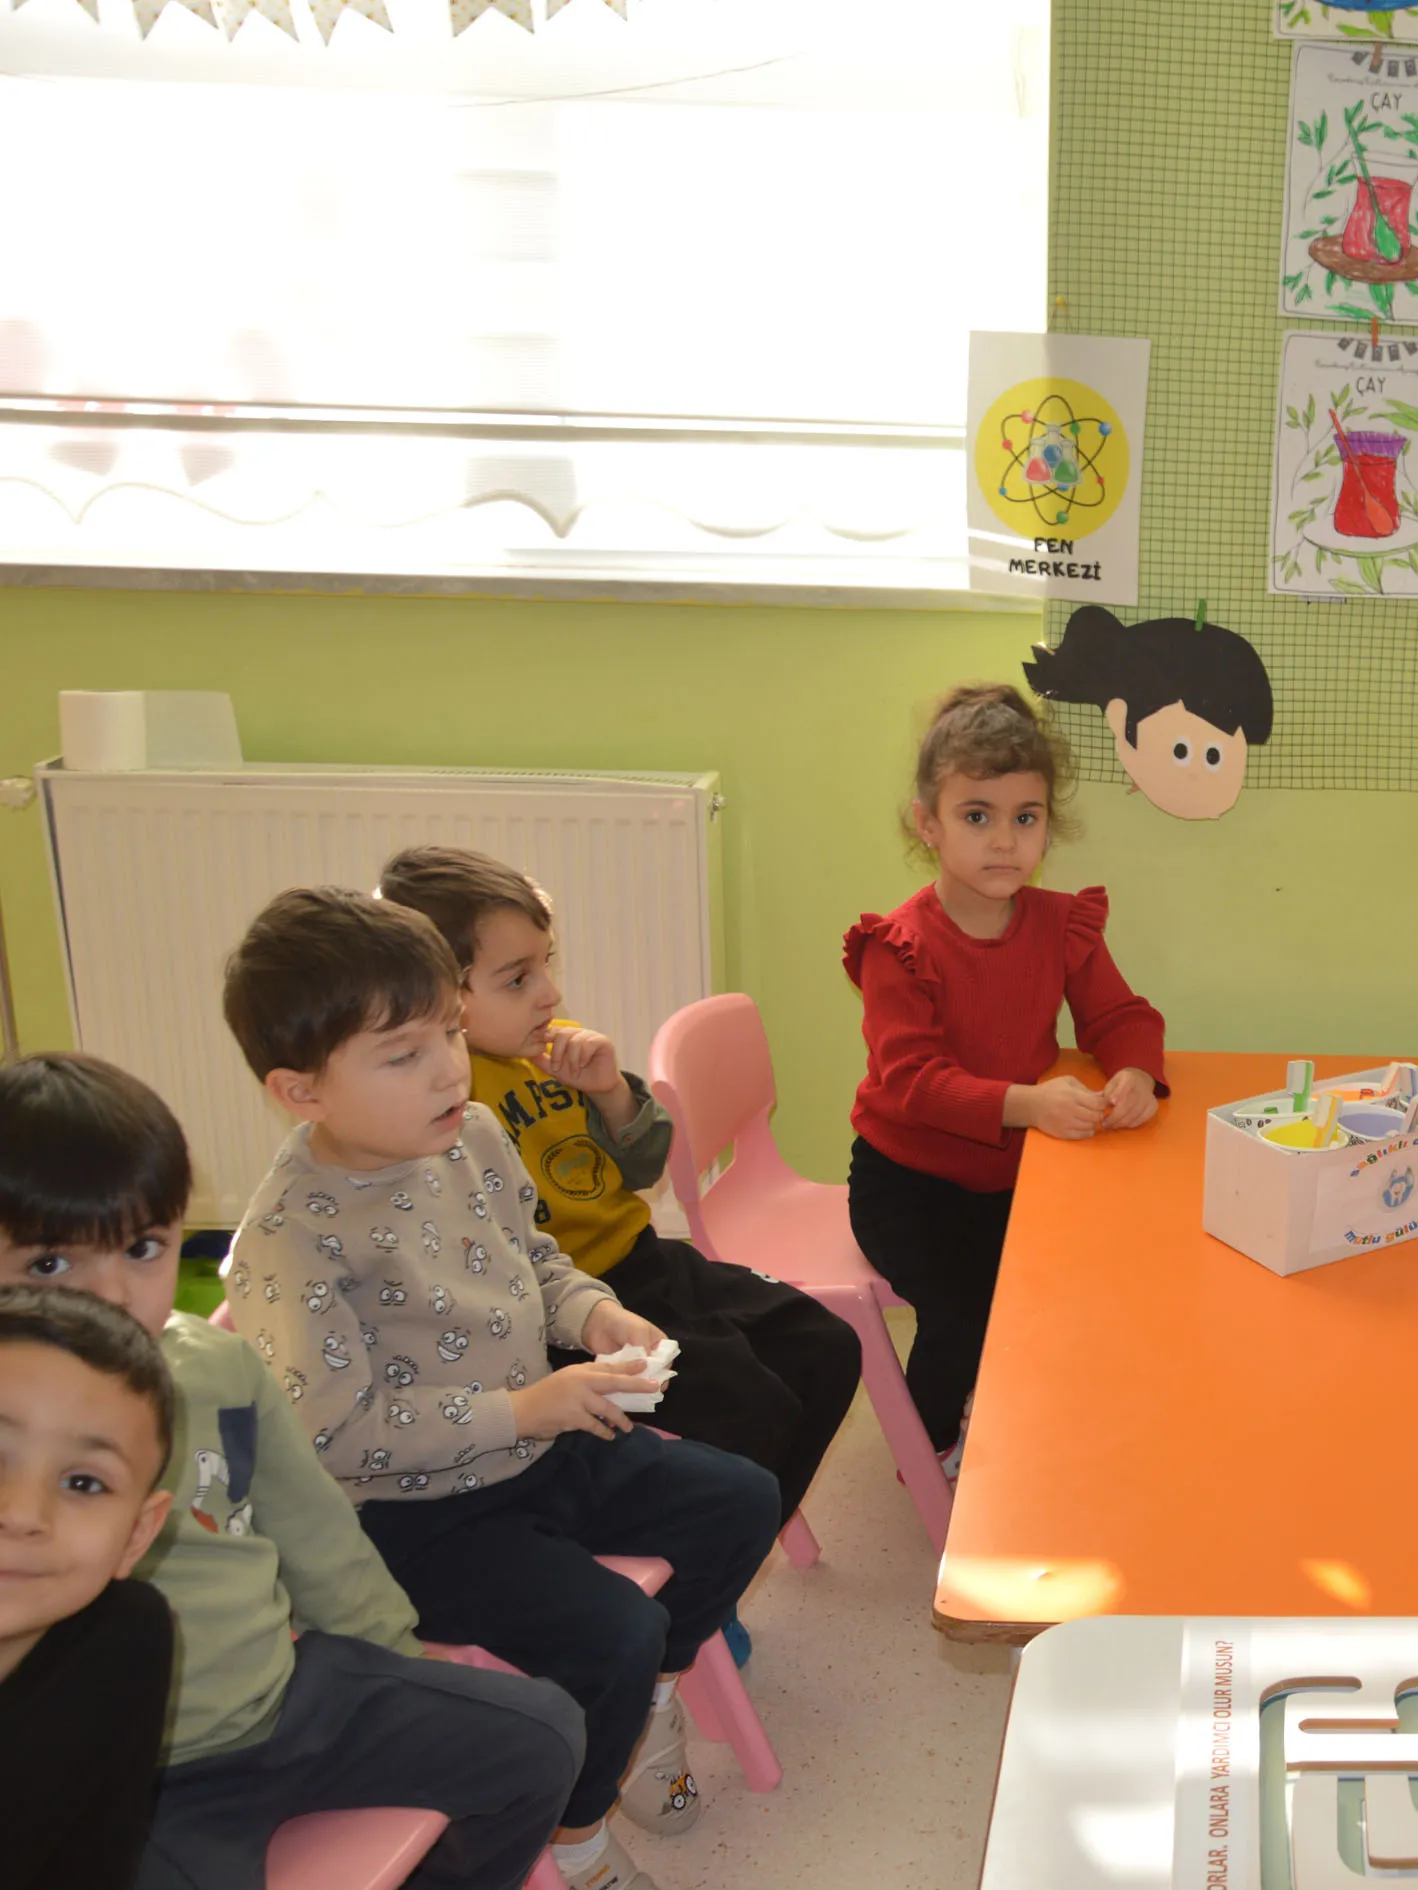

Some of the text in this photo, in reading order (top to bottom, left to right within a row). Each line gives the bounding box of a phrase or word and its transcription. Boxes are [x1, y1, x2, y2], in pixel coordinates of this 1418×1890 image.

[1371, 92, 1402, 113] ÇAY
[1356, 376, 1386, 396] ÇAY
[1034, 537, 1074, 554] FEN
[1008, 558, 1102, 580] MERKEZİ
[1214, 1640, 1234, 1686] MUSUN?
[1213, 1689, 1232, 1719] OLUR
[1210, 1722, 1231, 1780] YARDIMCI
[1208, 1785, 1230, 1838] ONLARA
